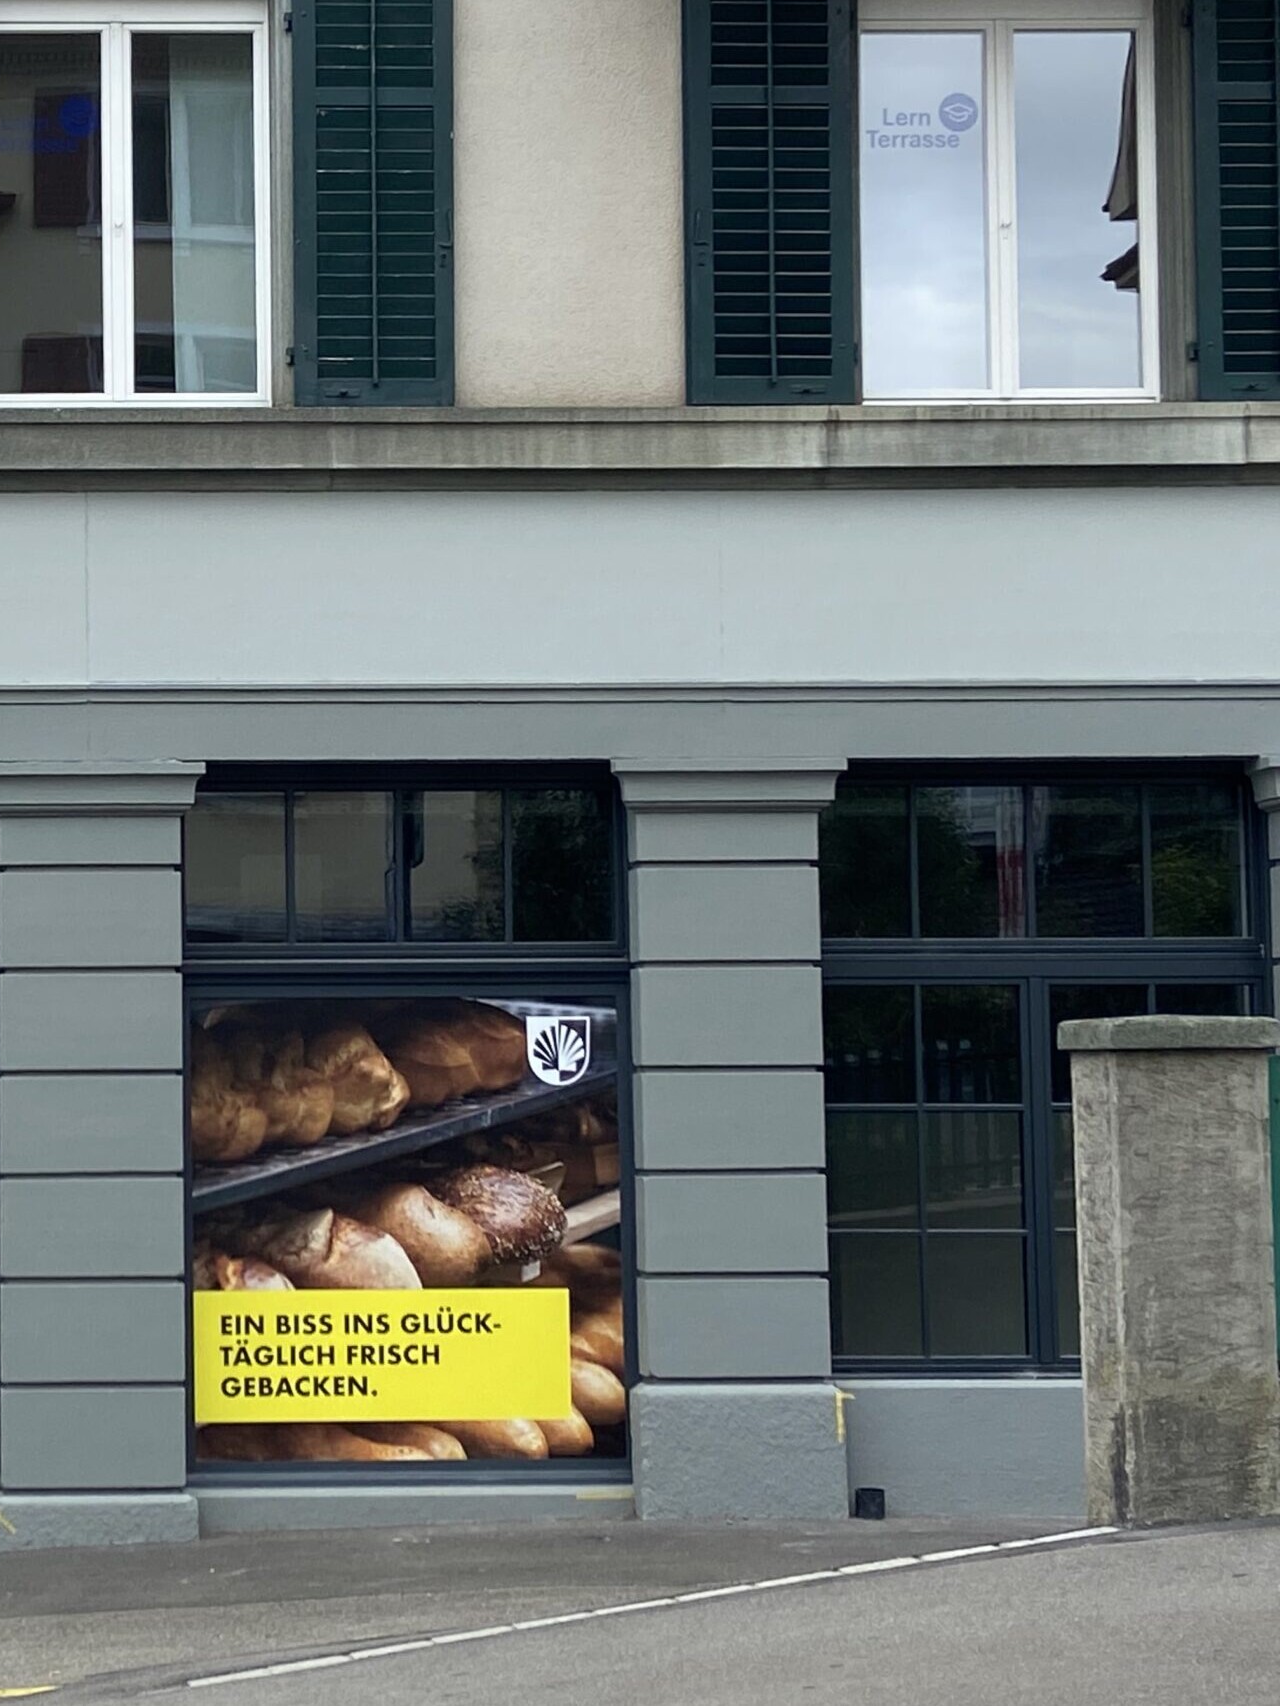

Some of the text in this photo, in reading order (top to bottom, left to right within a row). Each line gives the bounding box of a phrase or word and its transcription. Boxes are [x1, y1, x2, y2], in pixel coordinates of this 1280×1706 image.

[882, 107, 931, 126] Lern
[865, 129, 960, 149] Terrasse
[220, 1306, 502, 1336] EIN BISS INS GLÜCK-
[219, 1339, 440, 1367] TÄGLICH FRISCH
[220, 1375, 378, 1398] GEBACKEN.
